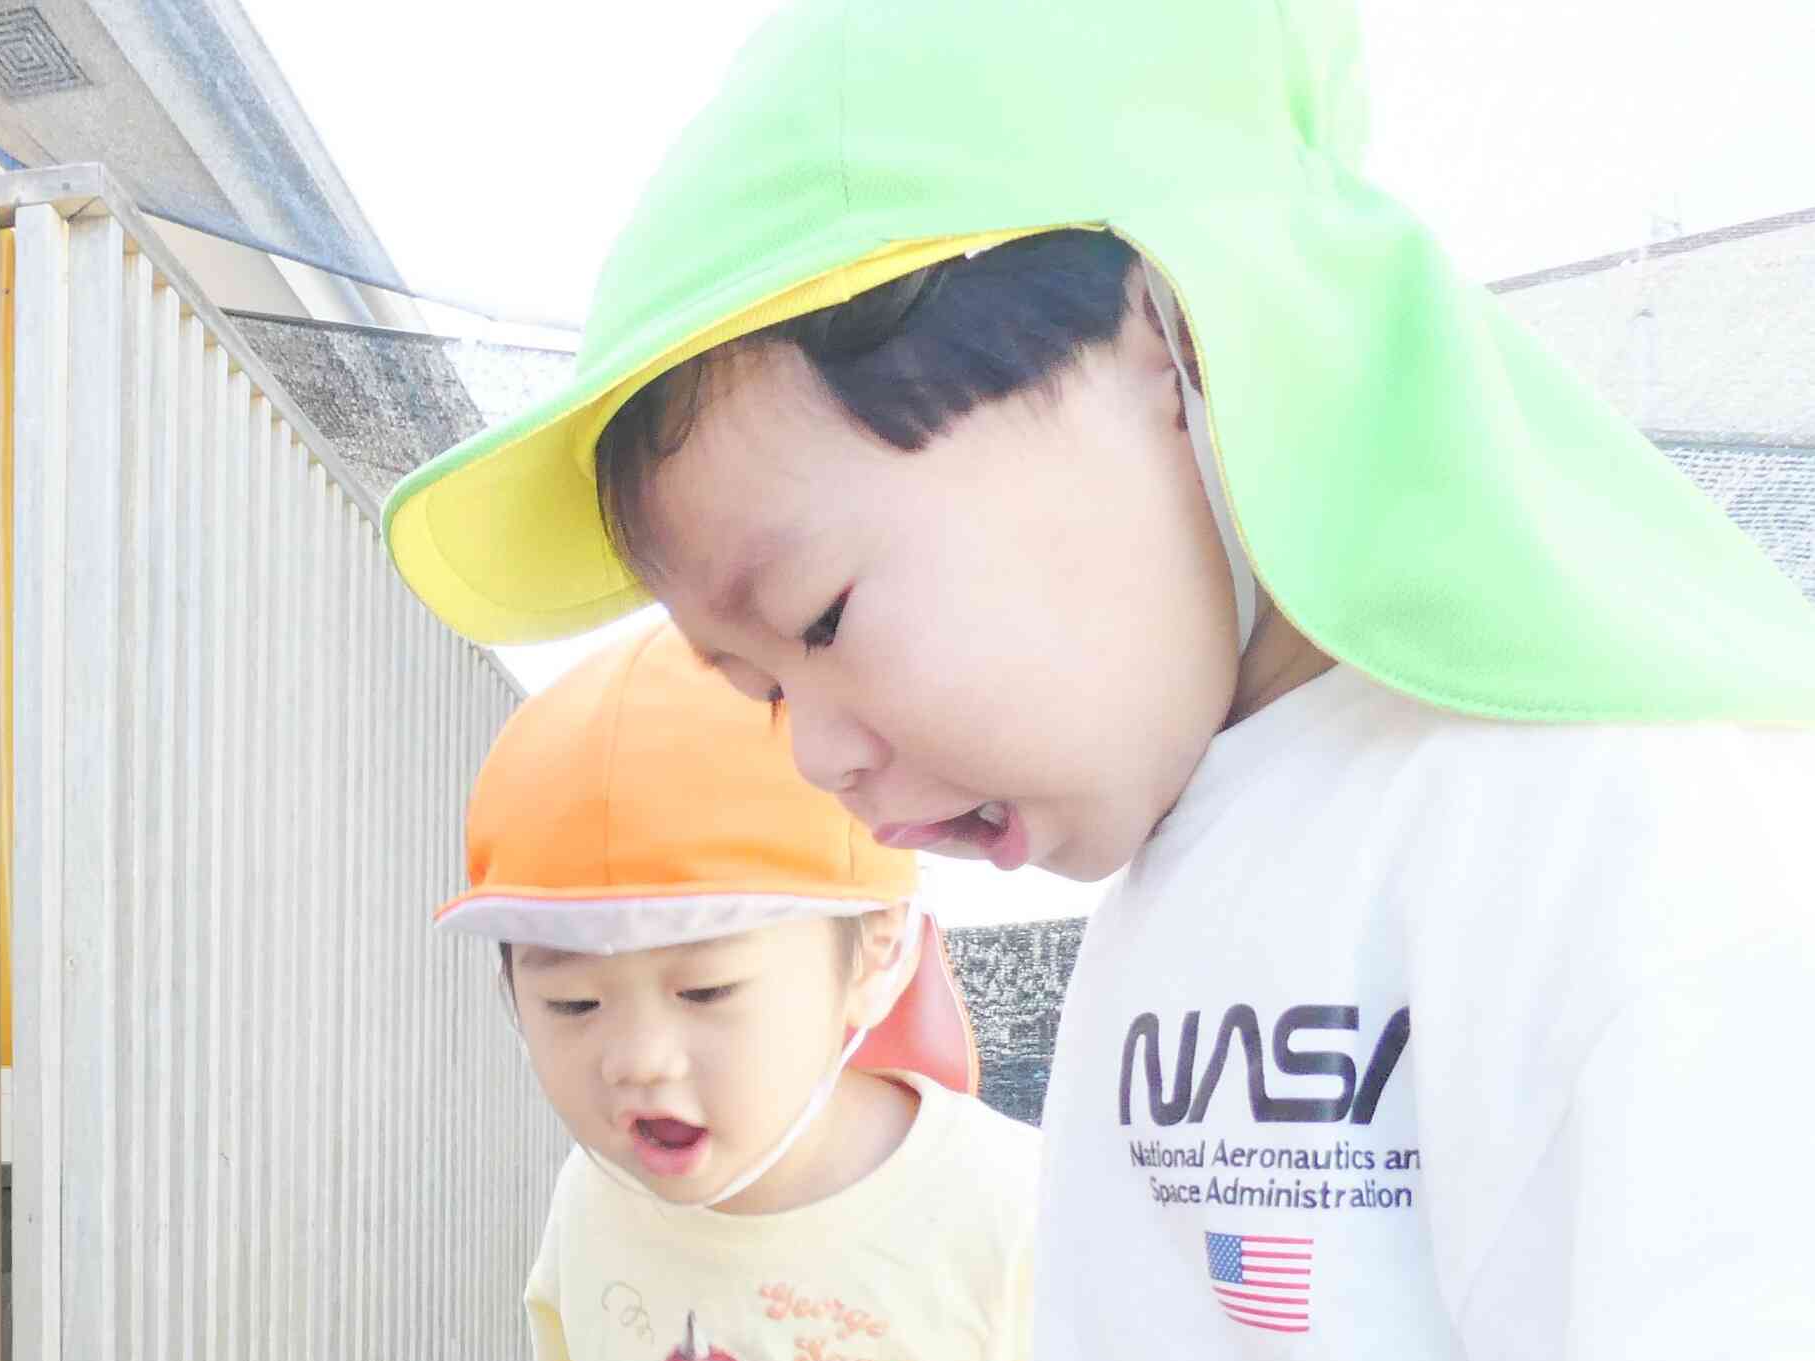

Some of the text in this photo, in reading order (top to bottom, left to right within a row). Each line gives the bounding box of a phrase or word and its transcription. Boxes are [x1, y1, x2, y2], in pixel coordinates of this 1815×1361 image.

[1130, 1140, 1422, 1171] National Aeronautics an
[1150, 1176, 1413, 1209] Space Administration
